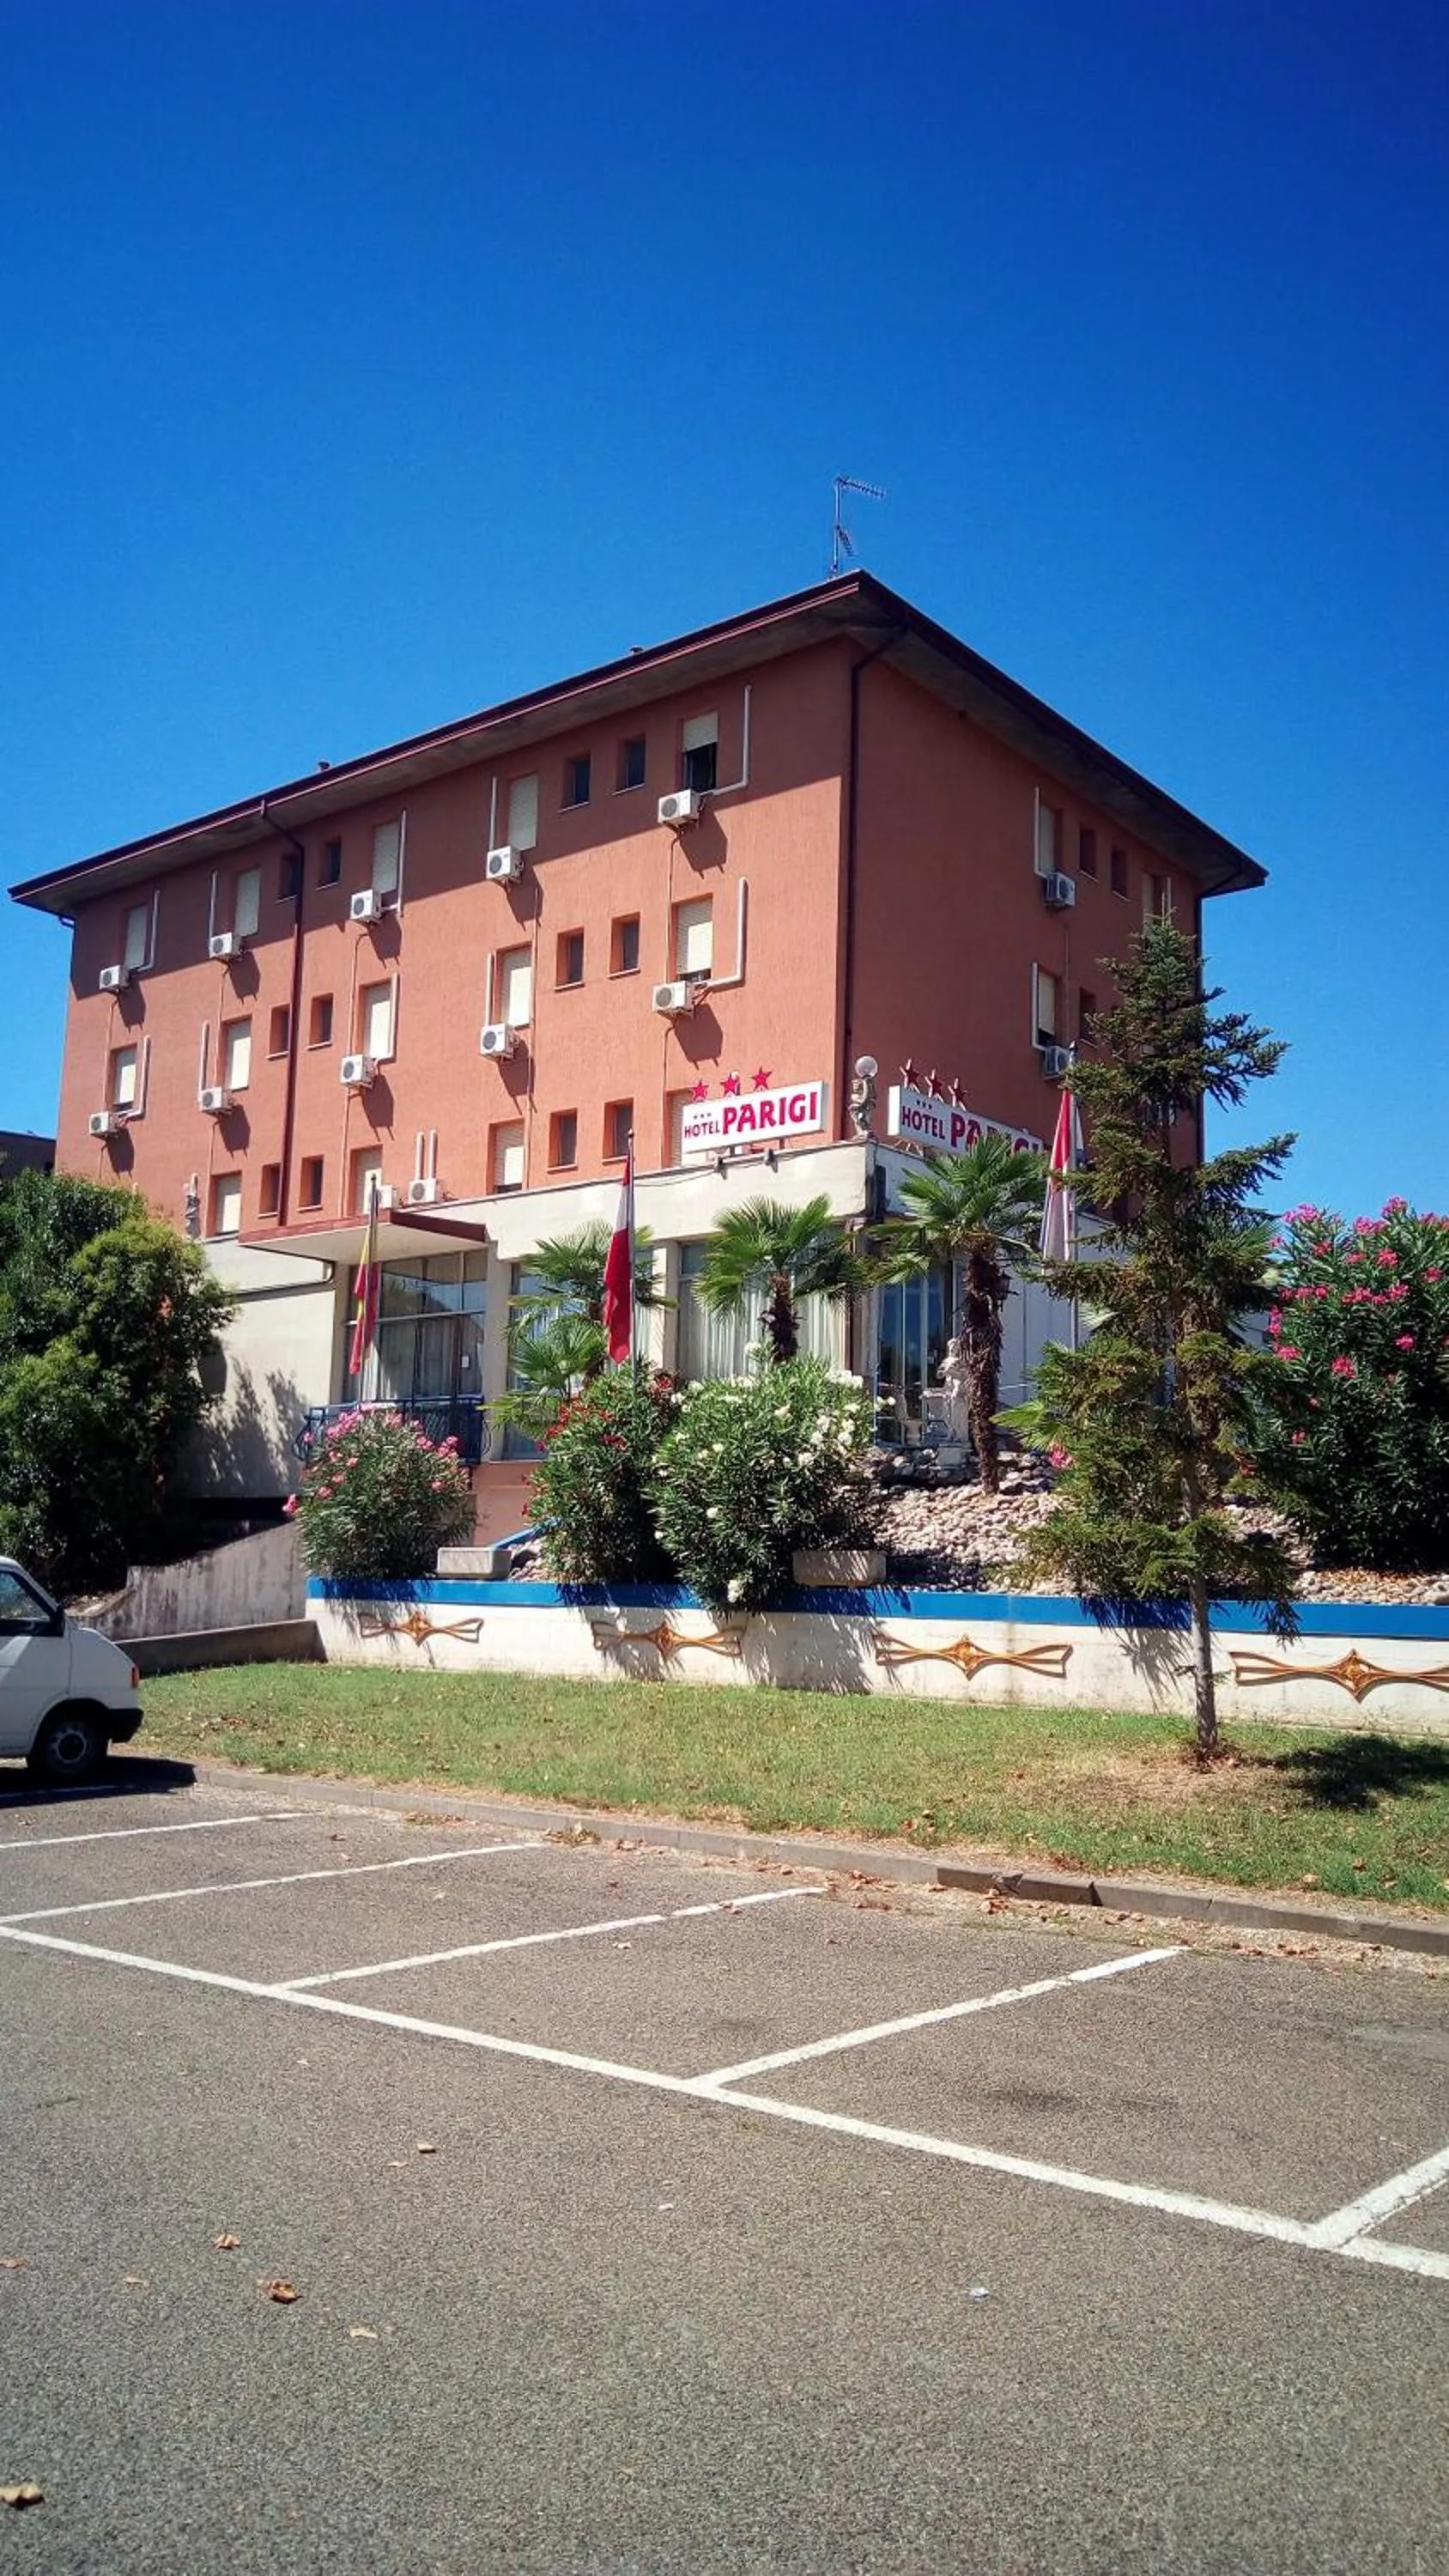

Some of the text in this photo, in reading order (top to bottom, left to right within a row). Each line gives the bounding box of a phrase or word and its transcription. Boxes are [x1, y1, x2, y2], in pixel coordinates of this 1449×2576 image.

[684, 1091, 818, 1139] HOTEL PARIGI
[901, 1105, 946, 1140] HOTEL
